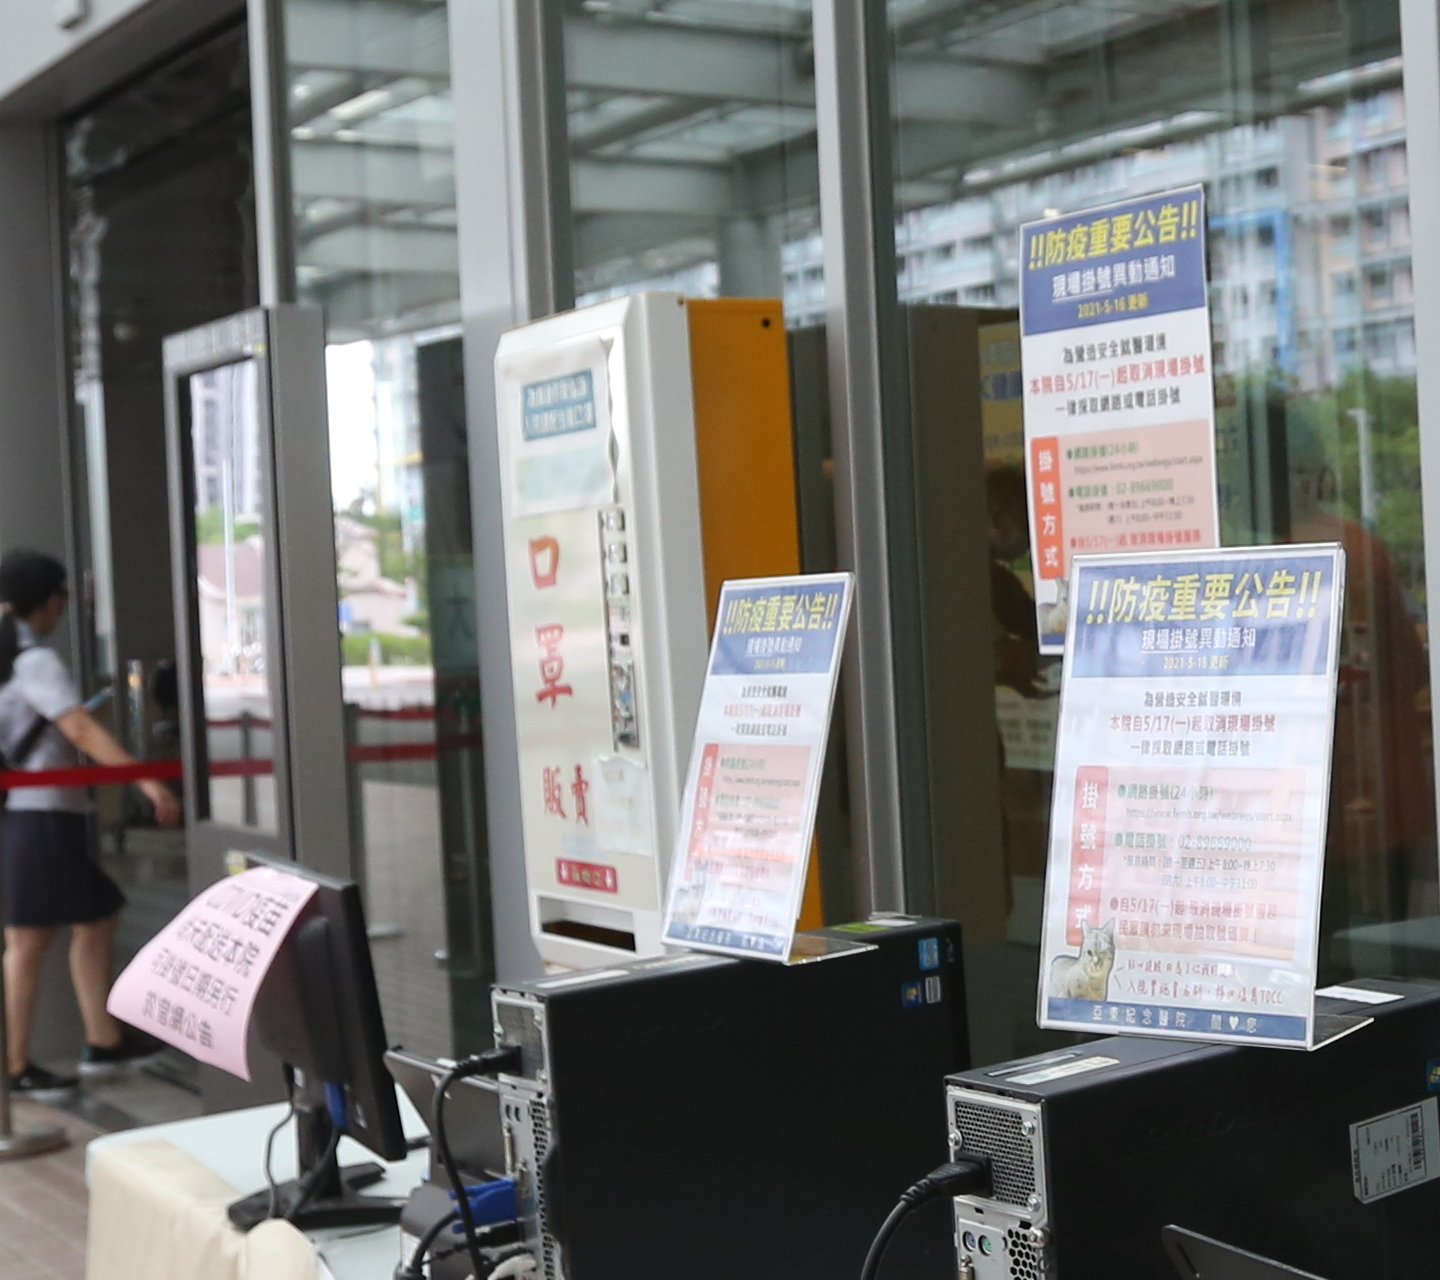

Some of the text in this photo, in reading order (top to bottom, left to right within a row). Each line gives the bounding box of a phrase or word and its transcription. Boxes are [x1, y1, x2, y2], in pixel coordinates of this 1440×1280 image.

[1052, 254, 1175, 298] 現場掛號異動通知
[1141, 627, 1256, 650] 現場掛號異動通知
